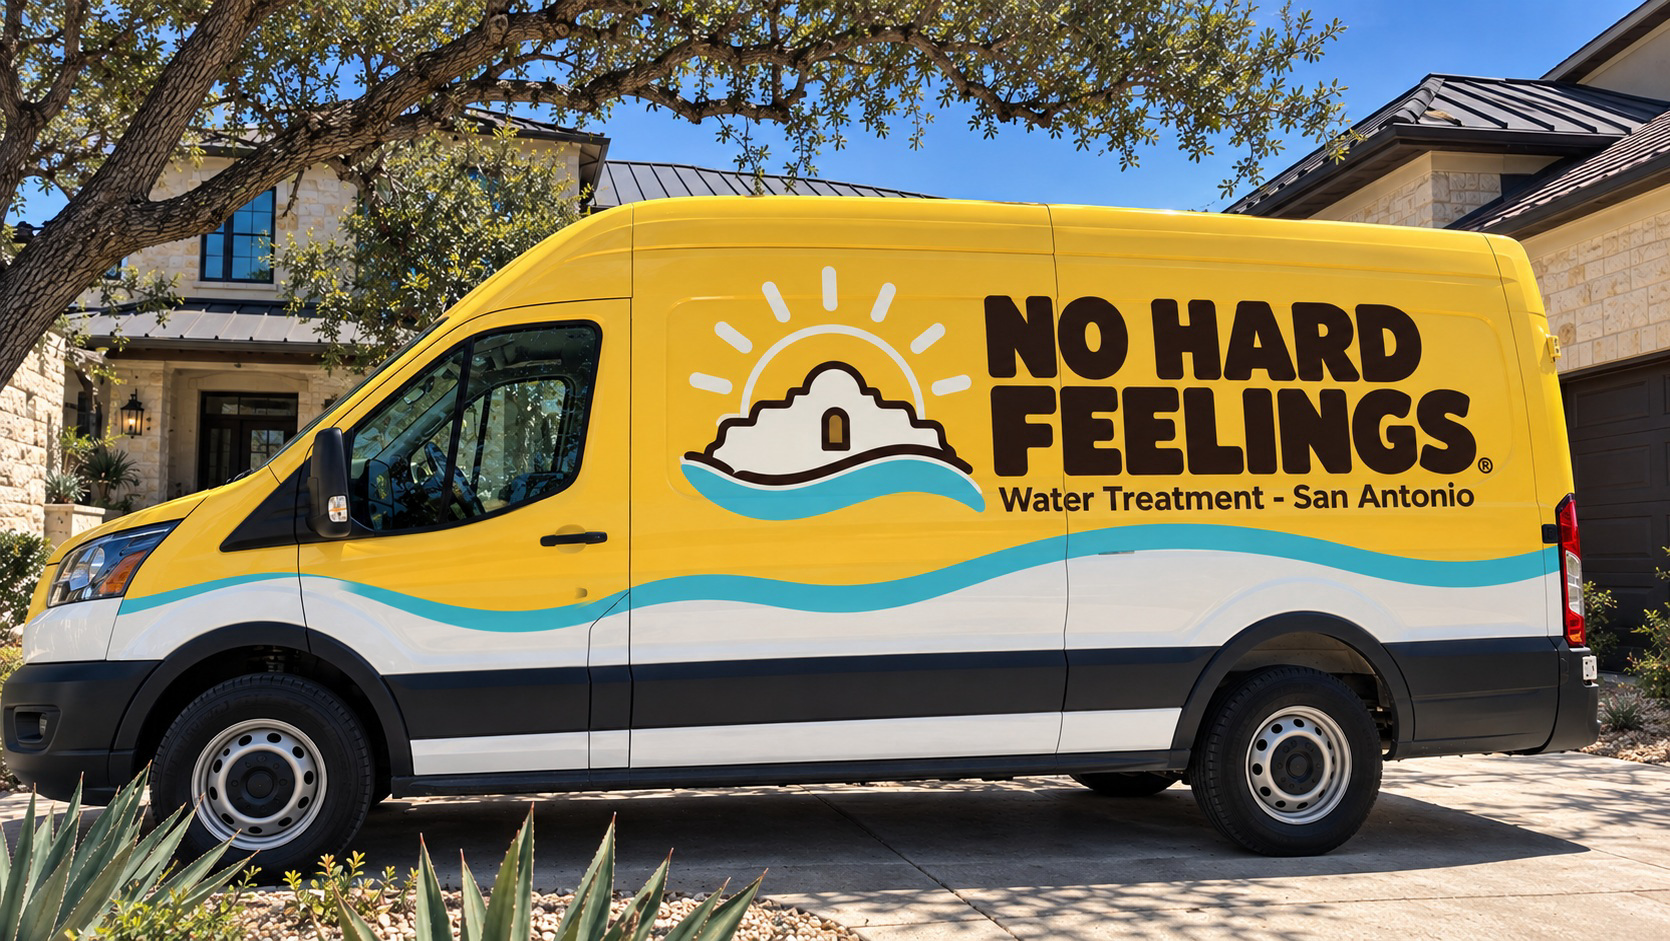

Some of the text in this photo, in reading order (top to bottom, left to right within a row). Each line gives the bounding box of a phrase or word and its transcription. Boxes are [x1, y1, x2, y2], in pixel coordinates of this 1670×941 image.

[984, 295, 1423, 382] NO HARD
[999, 487, 1095, 516] Water
[1103, 486, 1265, 511] Treatment
[1294, 485, 1349, 509] San
[1358, 482, 1475, 508] Antonio
